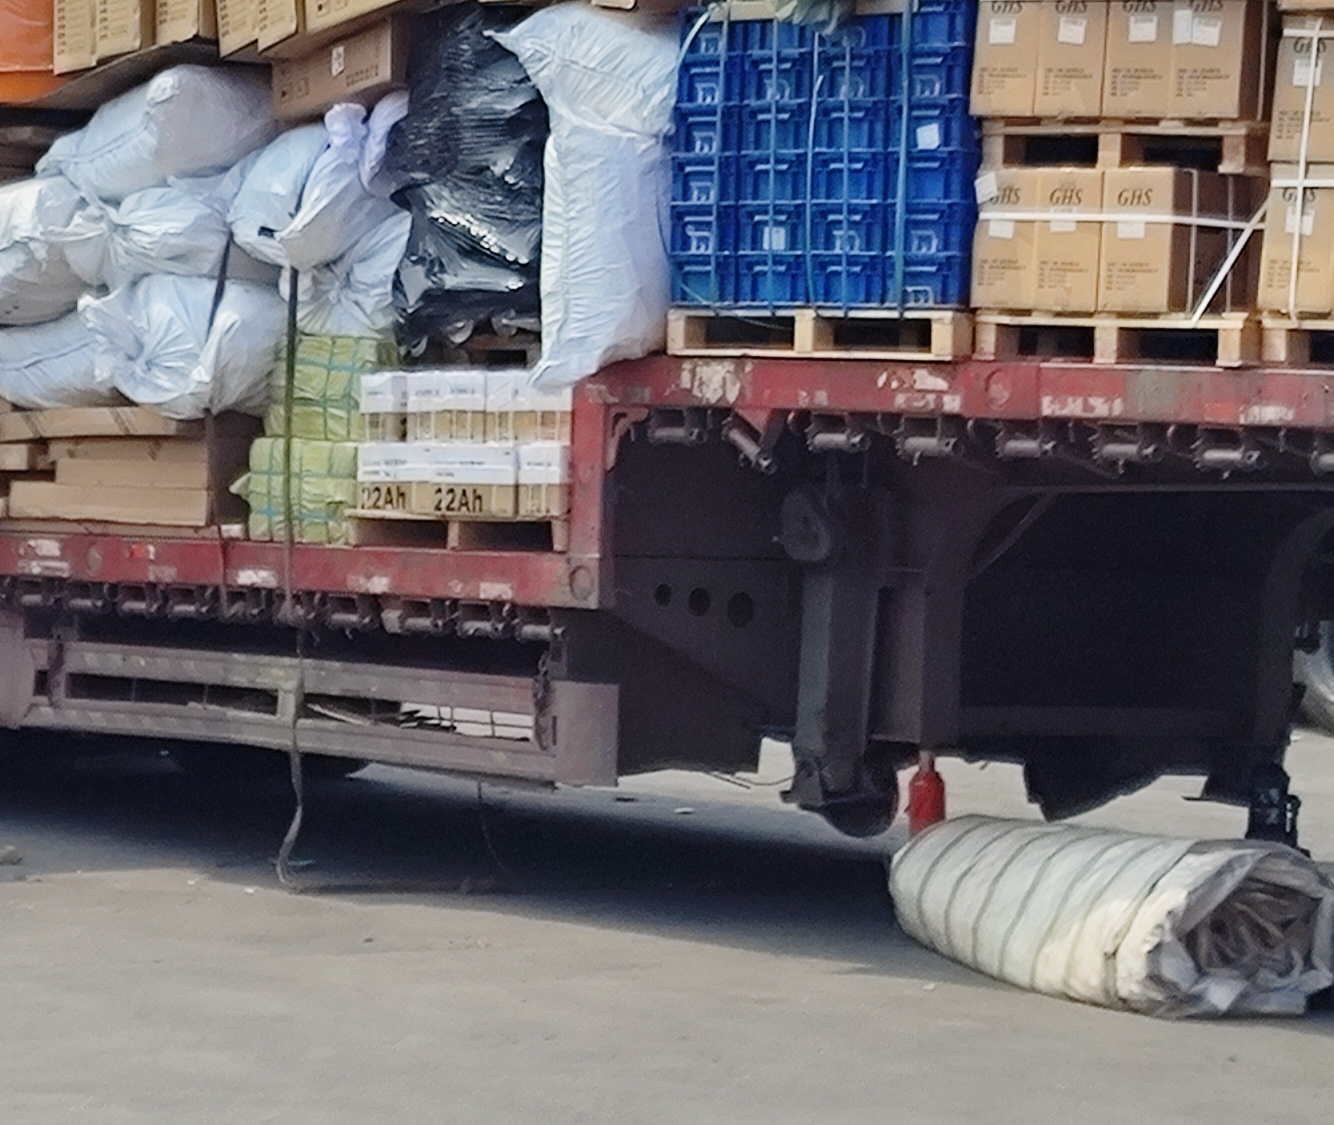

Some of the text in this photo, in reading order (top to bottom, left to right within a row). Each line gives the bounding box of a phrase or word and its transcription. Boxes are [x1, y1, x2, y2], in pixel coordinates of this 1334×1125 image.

[1049, 186, 1084, 207] GHS
[1117, 187, 1154, 207] GHS
[434, 487, 483, 513] 22Ah
